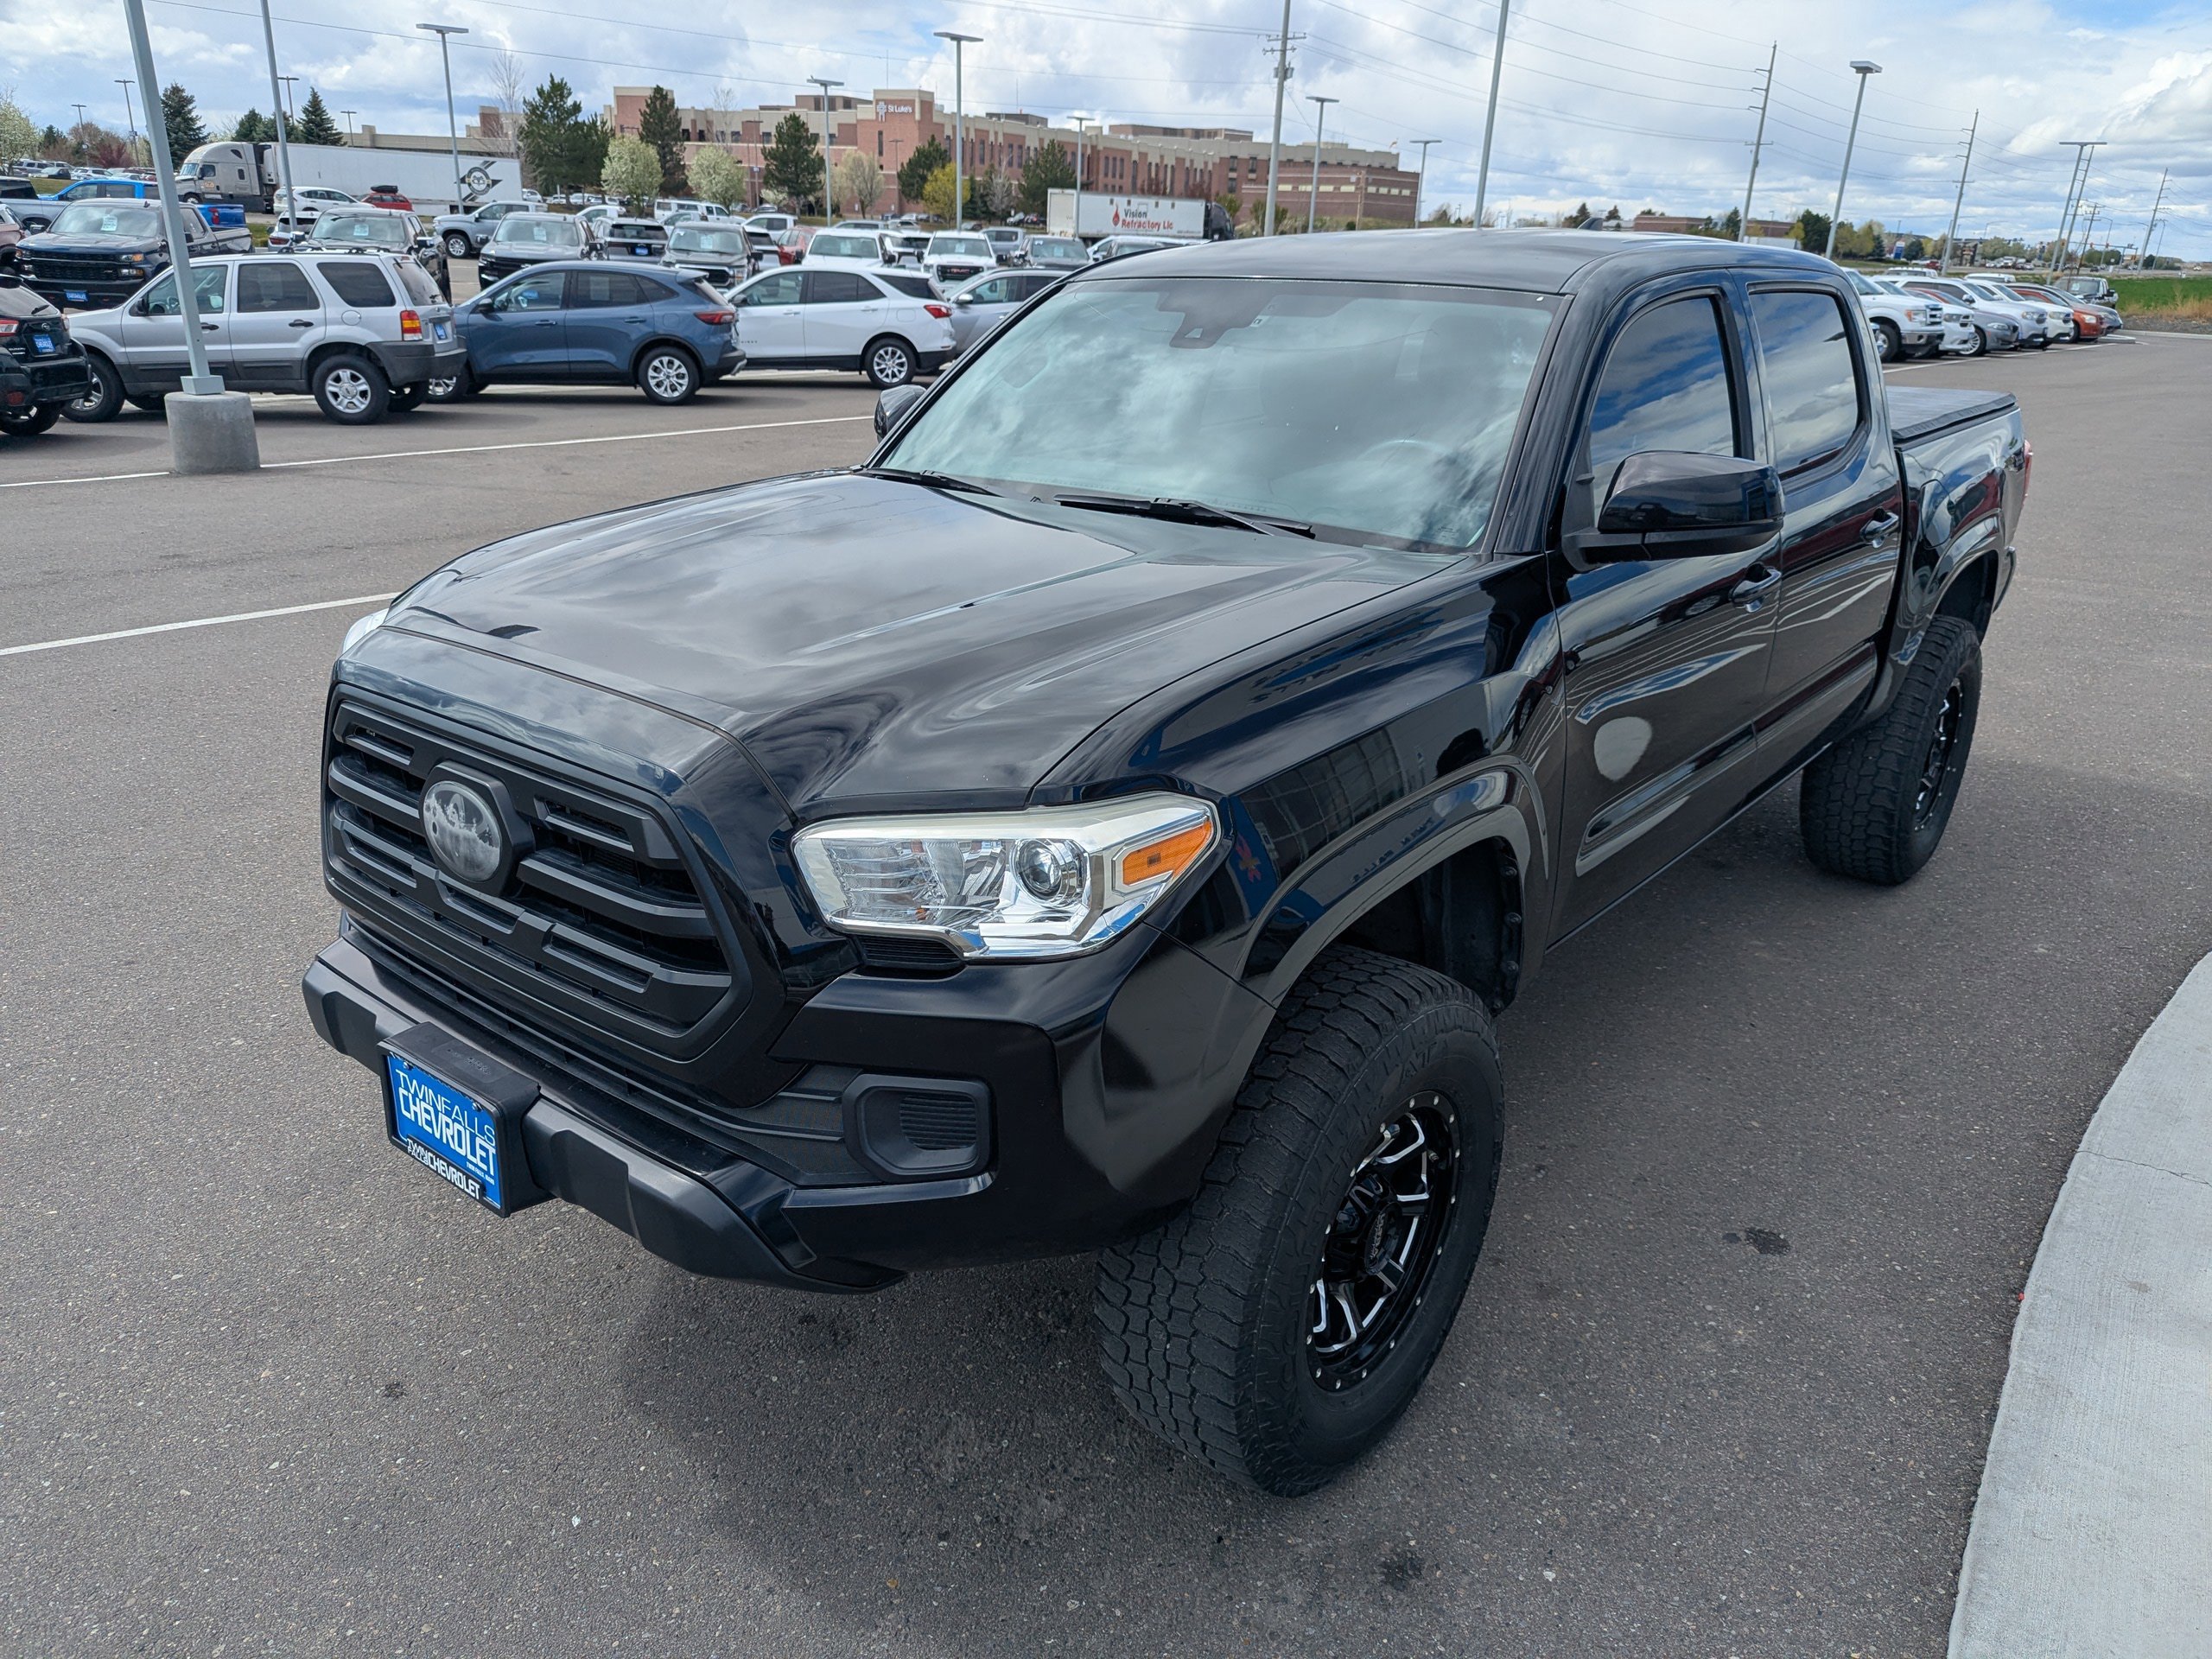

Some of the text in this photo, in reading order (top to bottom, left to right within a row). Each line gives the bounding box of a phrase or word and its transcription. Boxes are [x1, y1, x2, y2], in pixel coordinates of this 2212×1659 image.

[1122, 219, 1161, 231] Refractory
[1124, 208, 1147, 219] Vision
[398, 1086, 496, 1177] CHEVROLET
[428, 1152, 480, 1199] CHEVROLET
